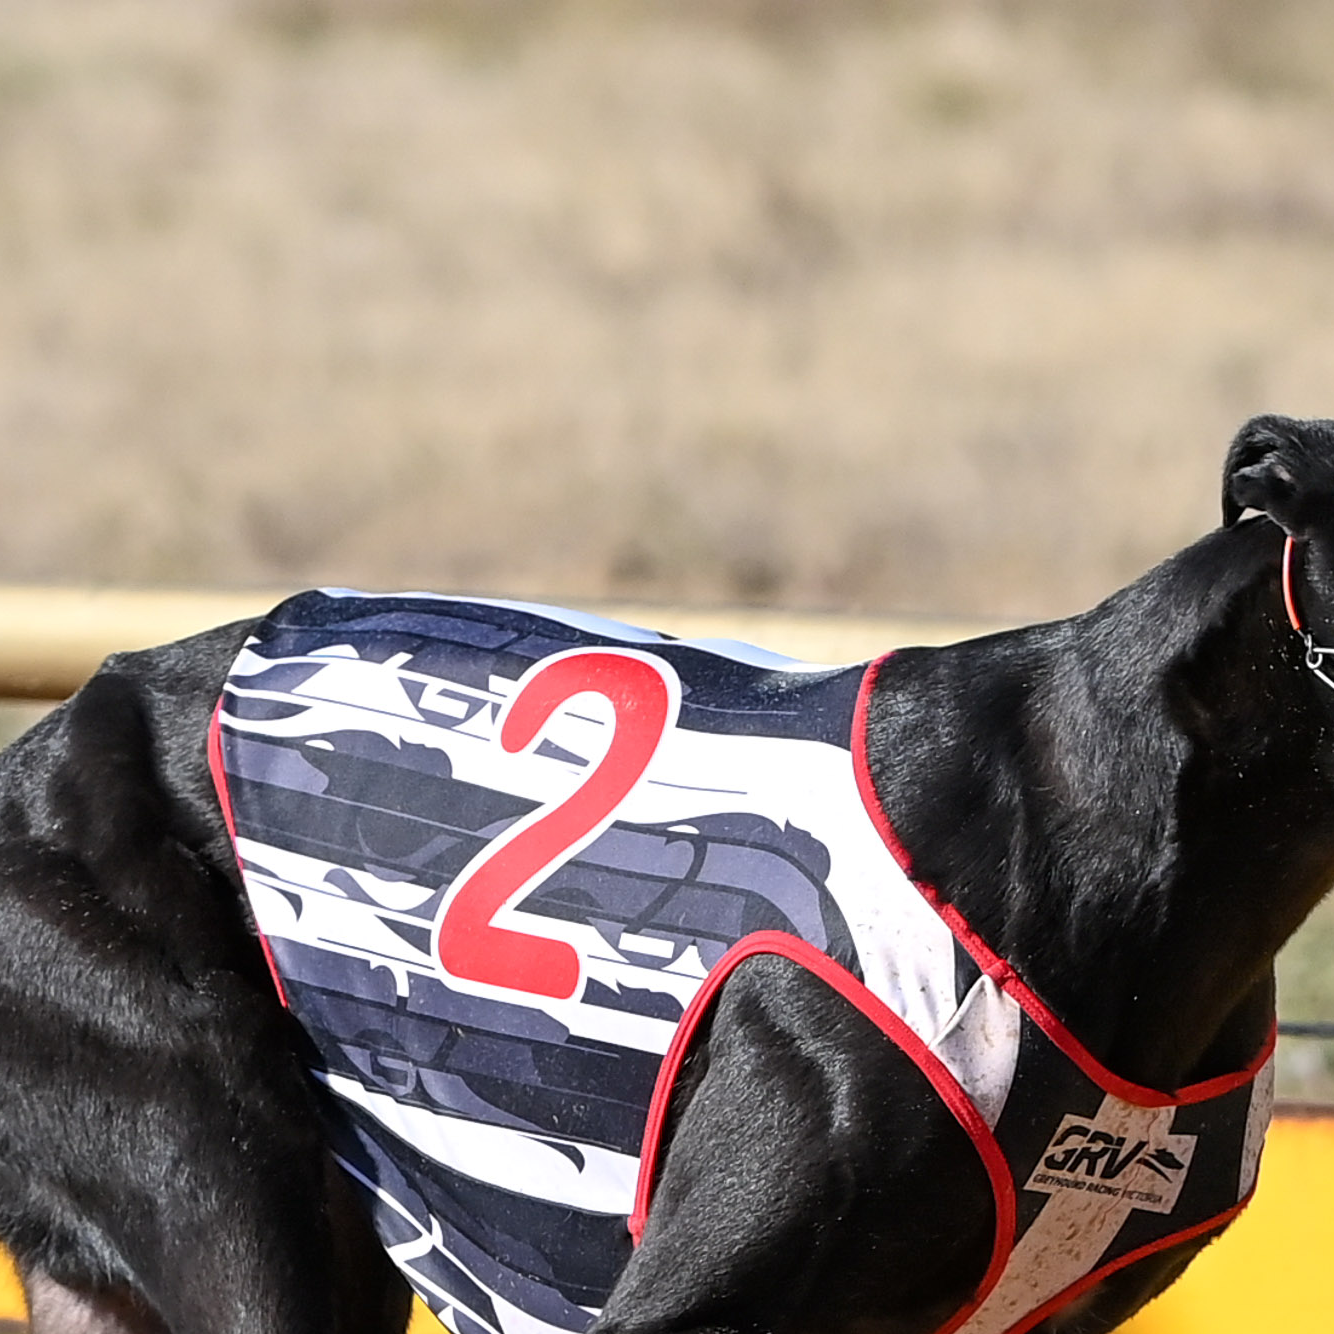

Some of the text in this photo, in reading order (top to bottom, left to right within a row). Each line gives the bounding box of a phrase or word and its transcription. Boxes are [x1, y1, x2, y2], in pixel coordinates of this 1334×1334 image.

[437, 648, 677, 1002] 2
[1044, 1124, 1149, 1179] GRV
[1032, 1173, 1087, 1191] GREYHOUND
[1085, 1181, 1122, 1197] RACING
